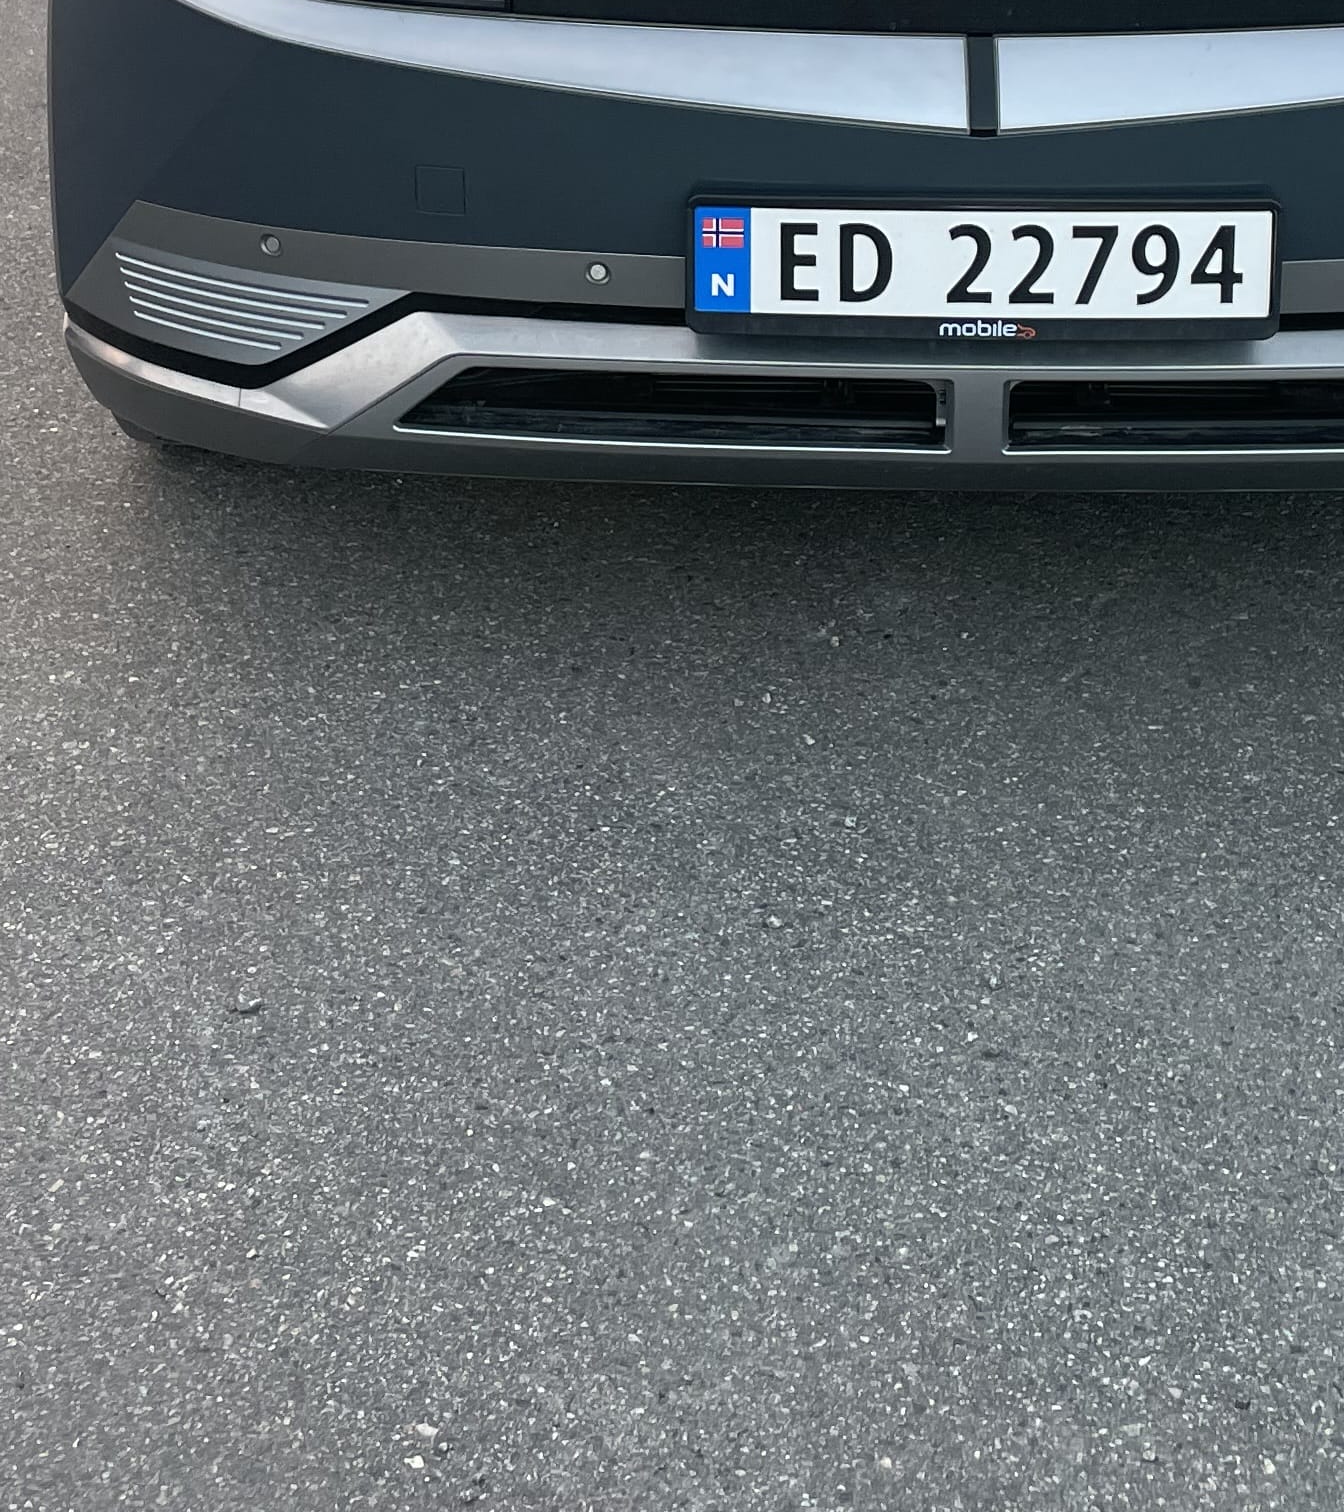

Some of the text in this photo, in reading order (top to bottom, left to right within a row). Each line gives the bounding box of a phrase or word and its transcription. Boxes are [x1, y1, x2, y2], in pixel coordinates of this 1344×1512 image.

[779, 222, 1244, 306] ED 22794
[711, 274, 735, 297] N
[939, 319, 1018, 337] mobile
